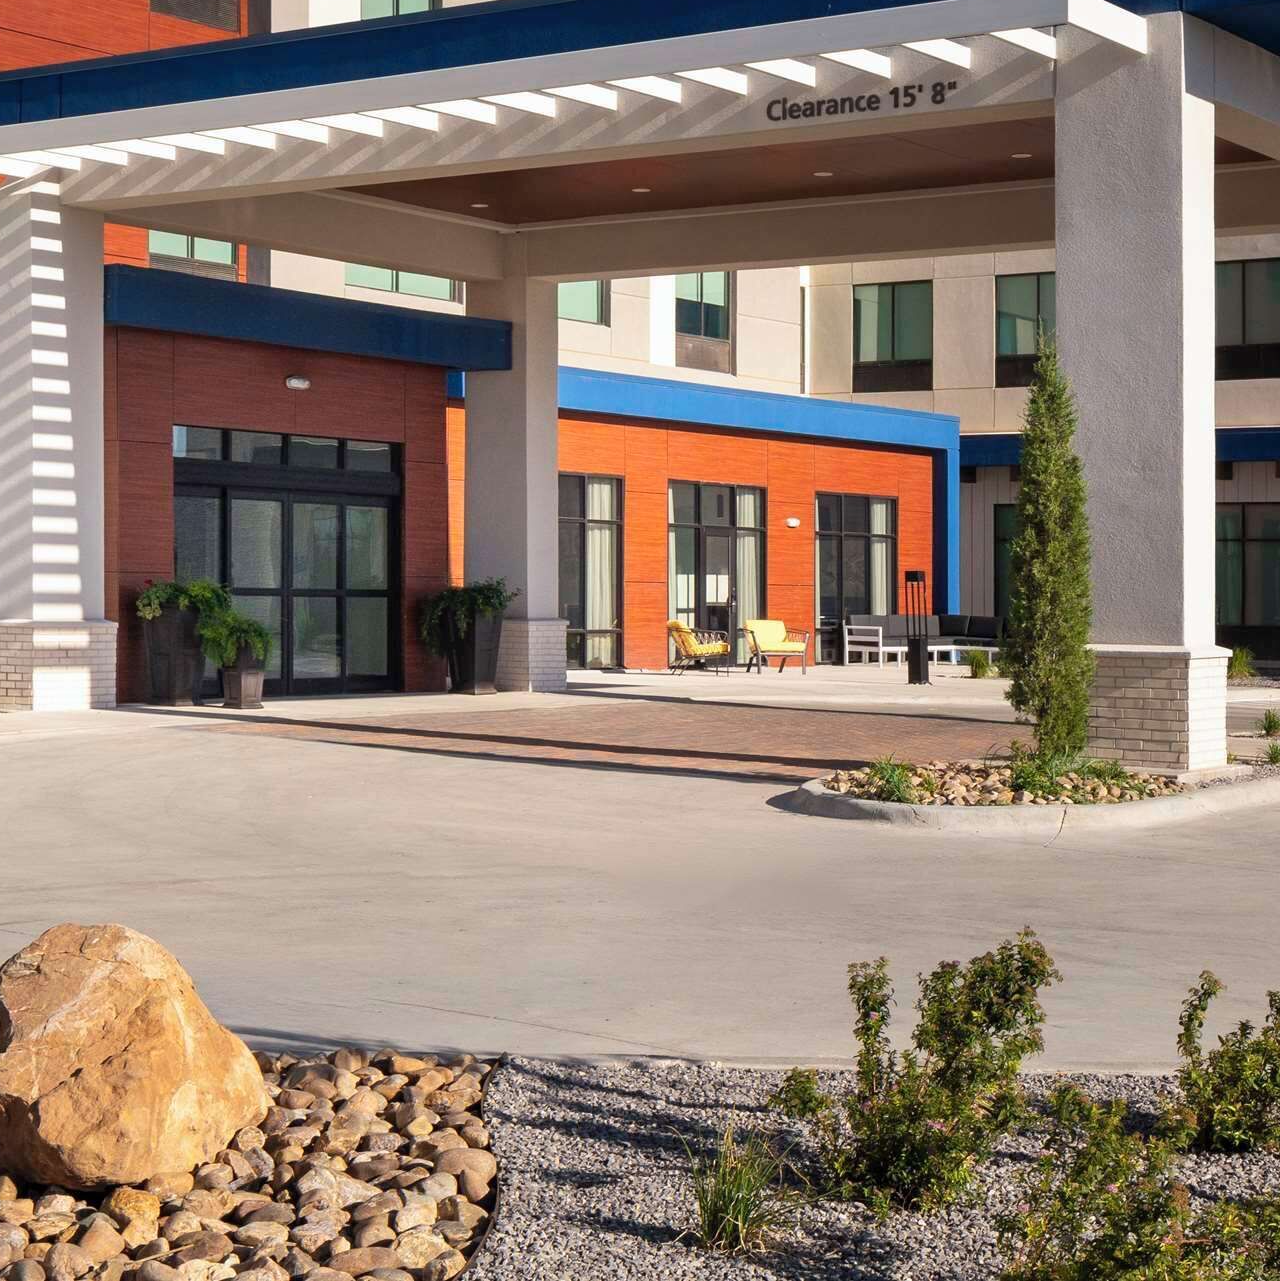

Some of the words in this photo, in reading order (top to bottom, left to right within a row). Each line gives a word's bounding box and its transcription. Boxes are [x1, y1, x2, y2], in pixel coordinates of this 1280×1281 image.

[766, 94, 881, 121] Clearance
[888, 84, 923, 109] 15'
[930, 81, 958, 105] 8"
